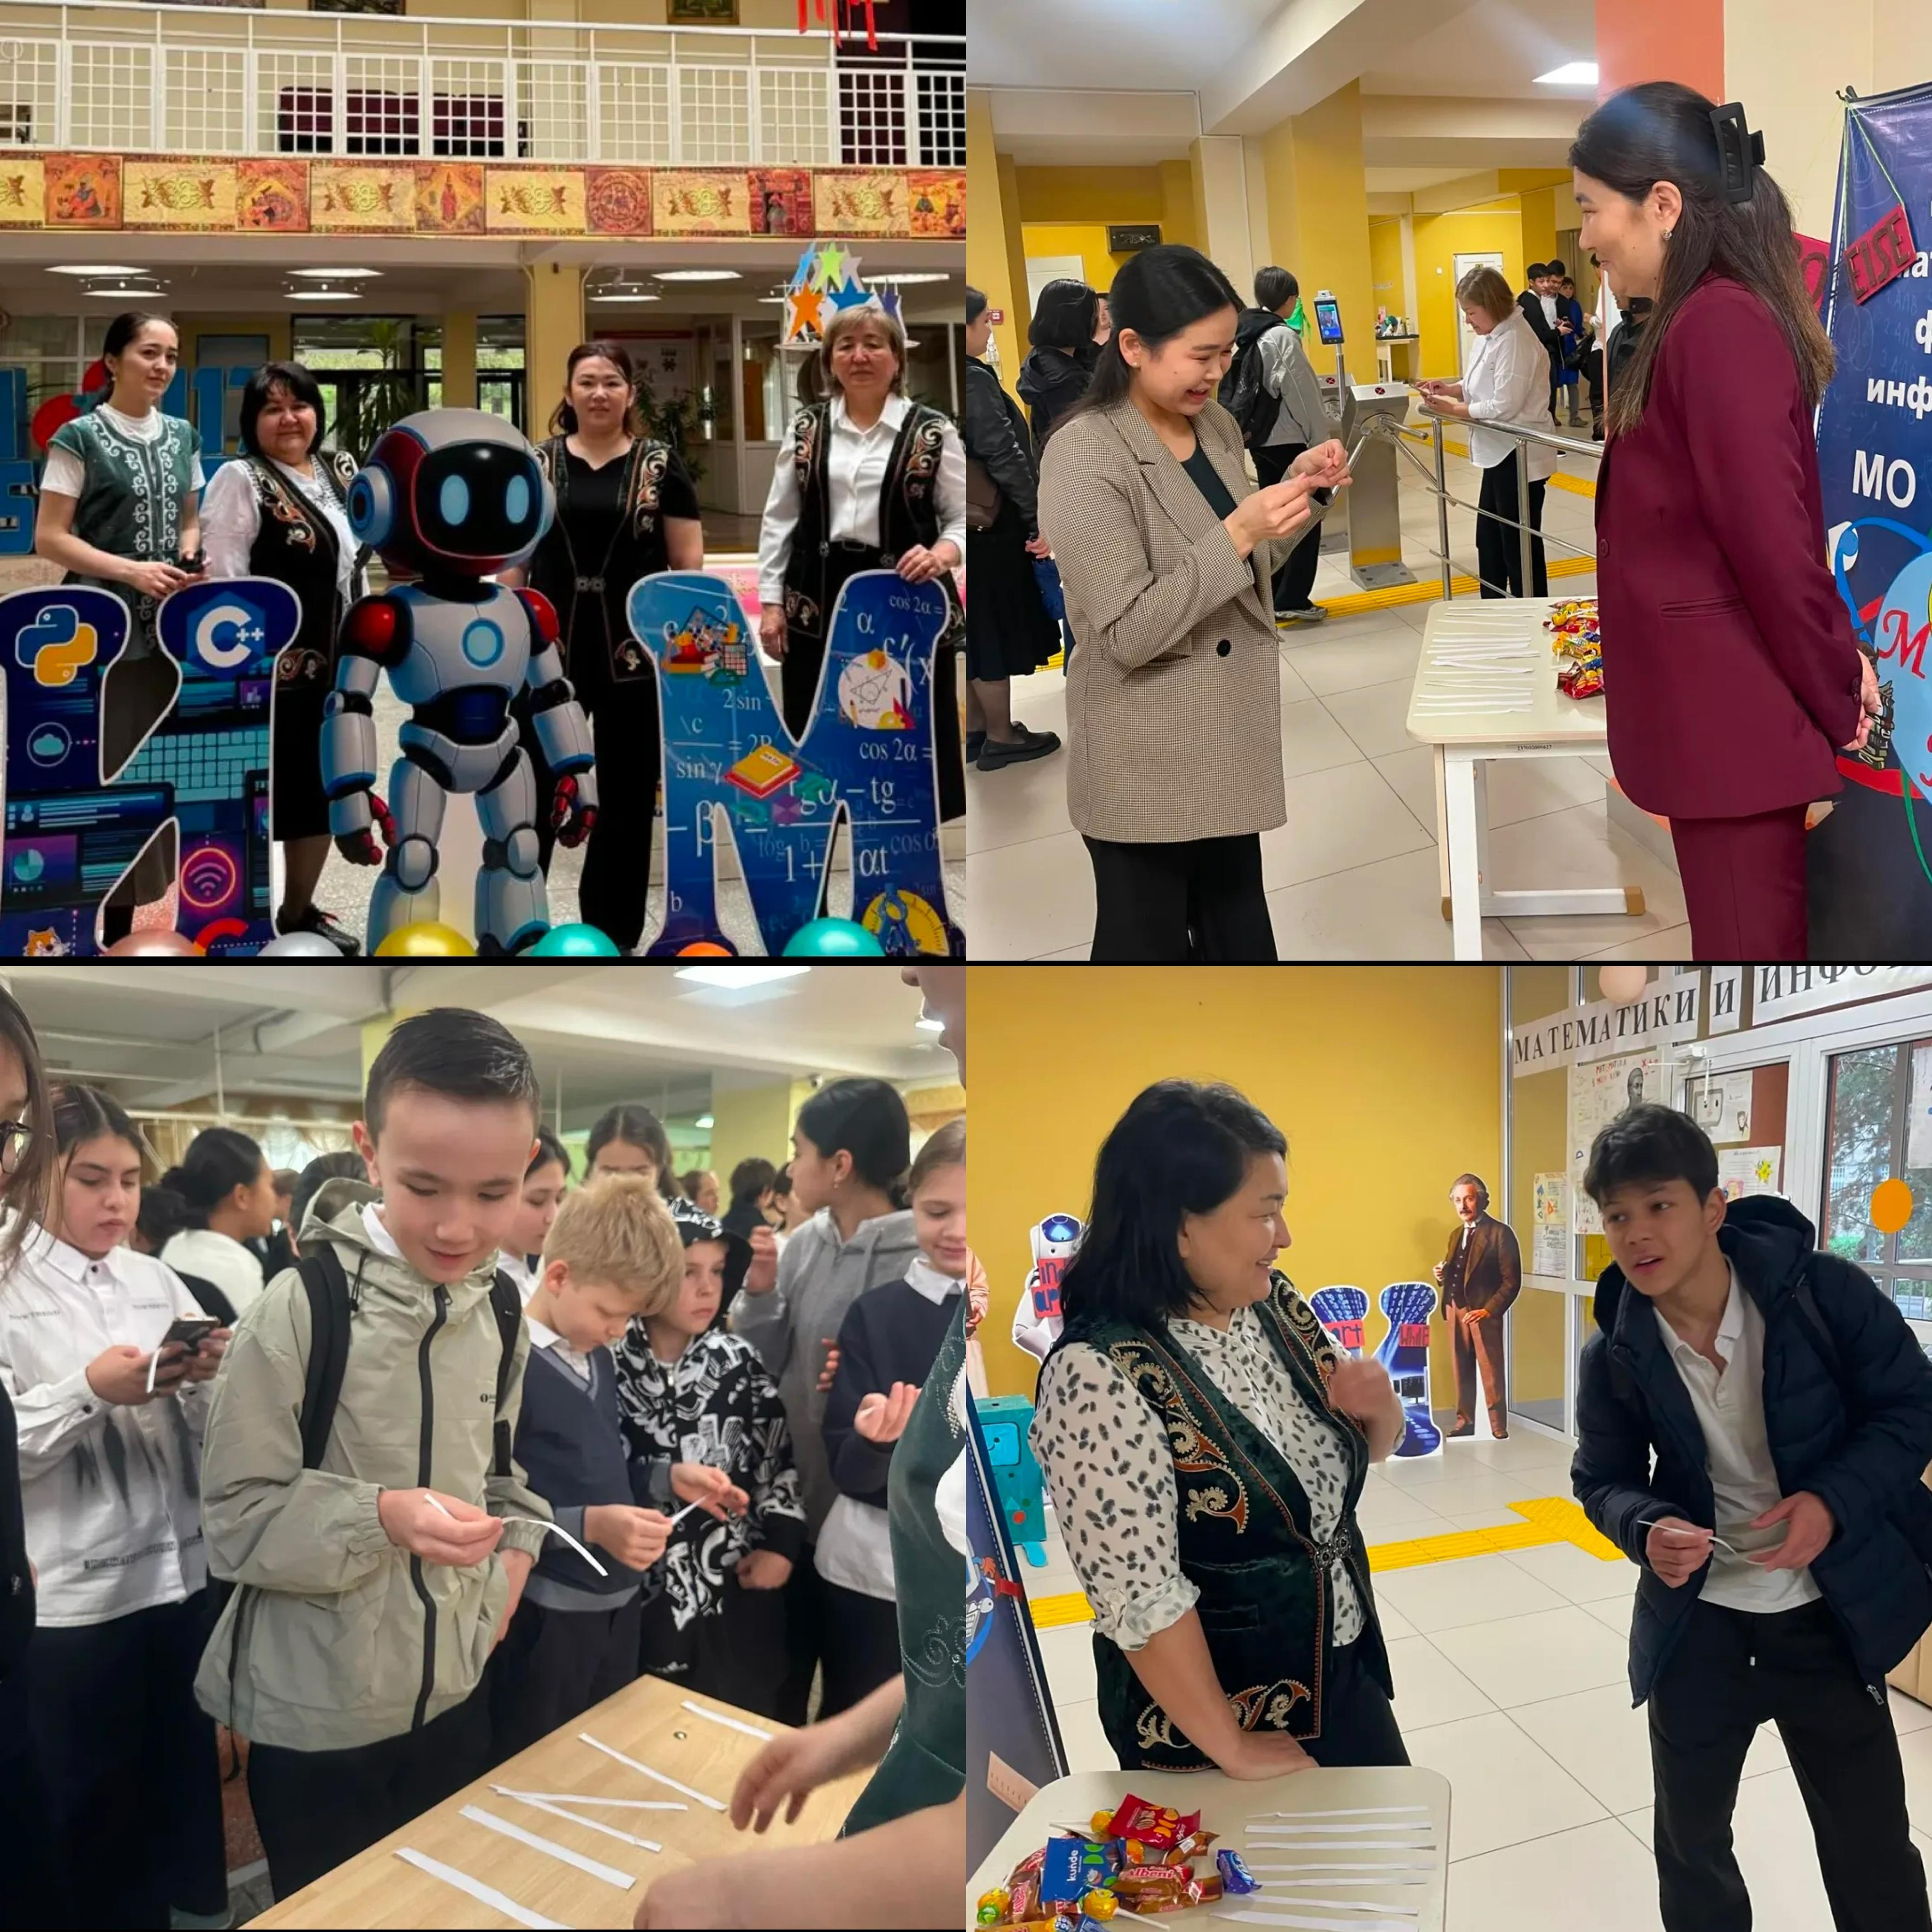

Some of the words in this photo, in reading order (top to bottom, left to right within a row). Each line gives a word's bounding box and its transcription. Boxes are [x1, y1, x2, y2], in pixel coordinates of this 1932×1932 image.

[1853, 449, 1916, 508] МО
[196, 605, 264, 668] C++
[860, 742, 888, 760] cos
[1514, 988, 1697, 1064] МАТЕМАТИКИ
[1712, 978, 1736, 1017] И
